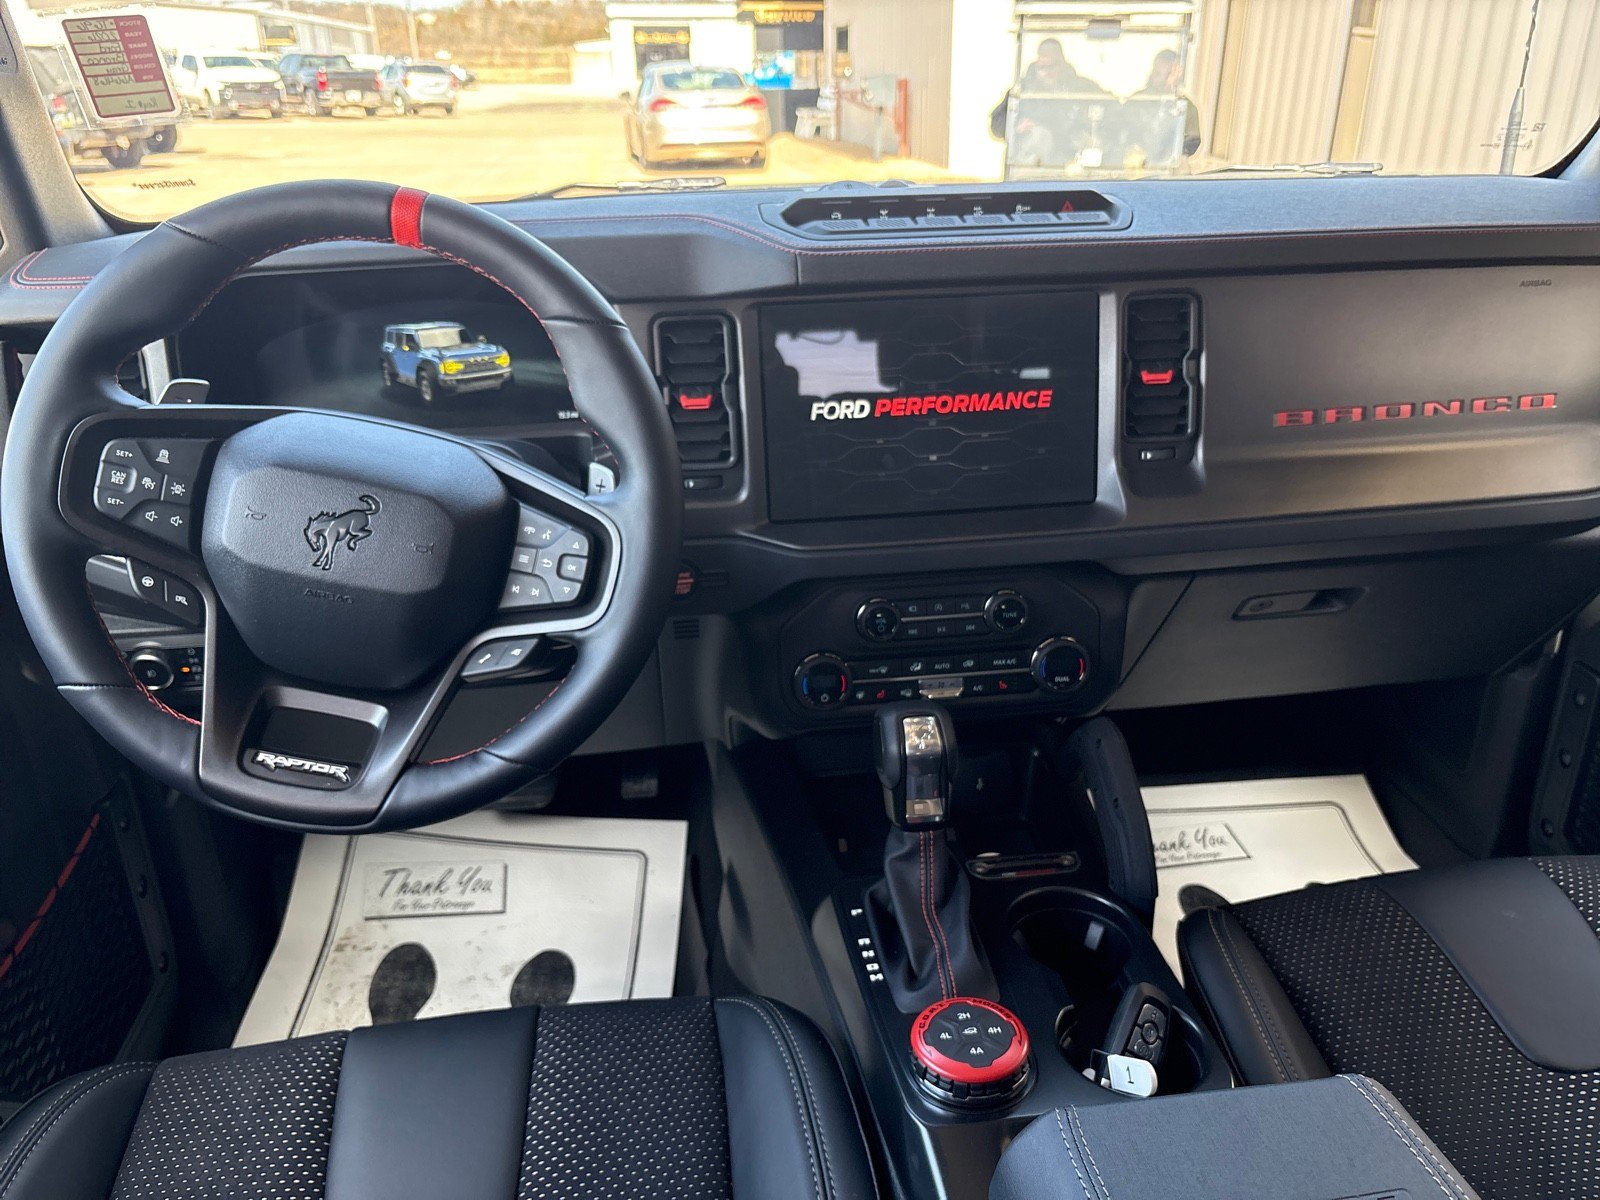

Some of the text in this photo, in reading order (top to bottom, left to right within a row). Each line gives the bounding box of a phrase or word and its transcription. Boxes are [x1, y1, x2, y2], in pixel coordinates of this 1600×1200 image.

[1519, 279, 1553, 288] AIRBAG
[810, 389, 1053, 421] FORD PERFORMANCE
[1273, 392, 1558, 428] BRONCO
[116, 449, 133, 458] SET+
[111, 470, 127, 478] CAN
[567, 563, 577, 572] OK
[1002, 611, 1017, 619] TUNE
[1054, 675, 1070, 683] DUAL
[972, 684, 983, 692] A/C
[255, 752, 349, 782] RAPTOR
[1194, 827, 1228, 849] You
[378, 865, 494, 898] Thank You
[866, 963, 879, 971] D
[957, 1012, 971, 1021] 2H
[987, 1026, 1002, 1035] 4H
[940, 1032, 952, 1040] 4L
[969, 1046, 984, 1055] 4A
[1125, 1065, 1135, 1084] 1
